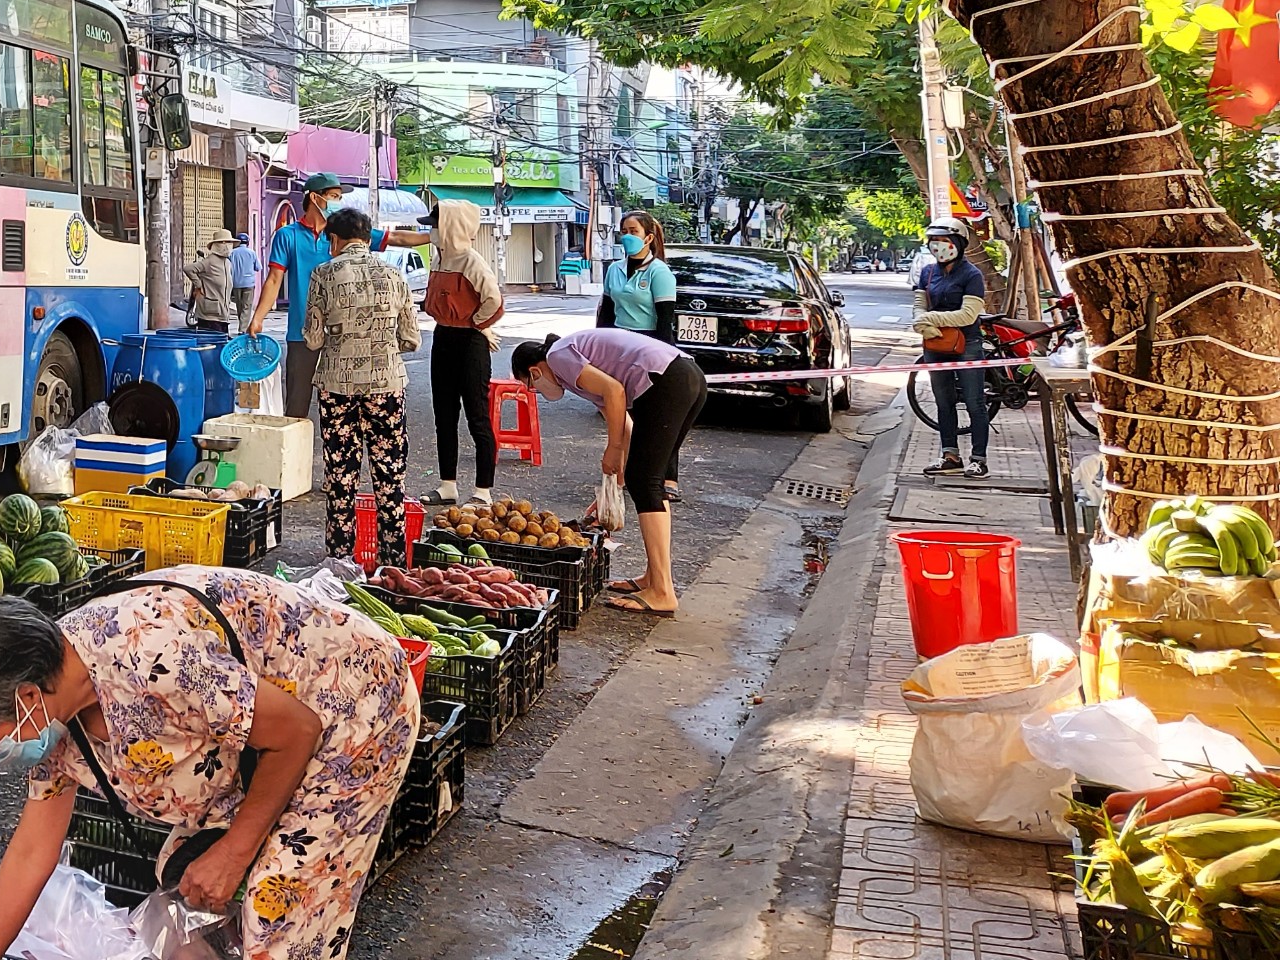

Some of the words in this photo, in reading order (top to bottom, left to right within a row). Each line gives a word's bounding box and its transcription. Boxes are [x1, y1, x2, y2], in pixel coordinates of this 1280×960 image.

[85, 23, 111, 44] SAMCO
[453, 166, 468, 174] Tea
[687, 316, 708, 330] 79A
[679, 328, 716, 342] 203.78
